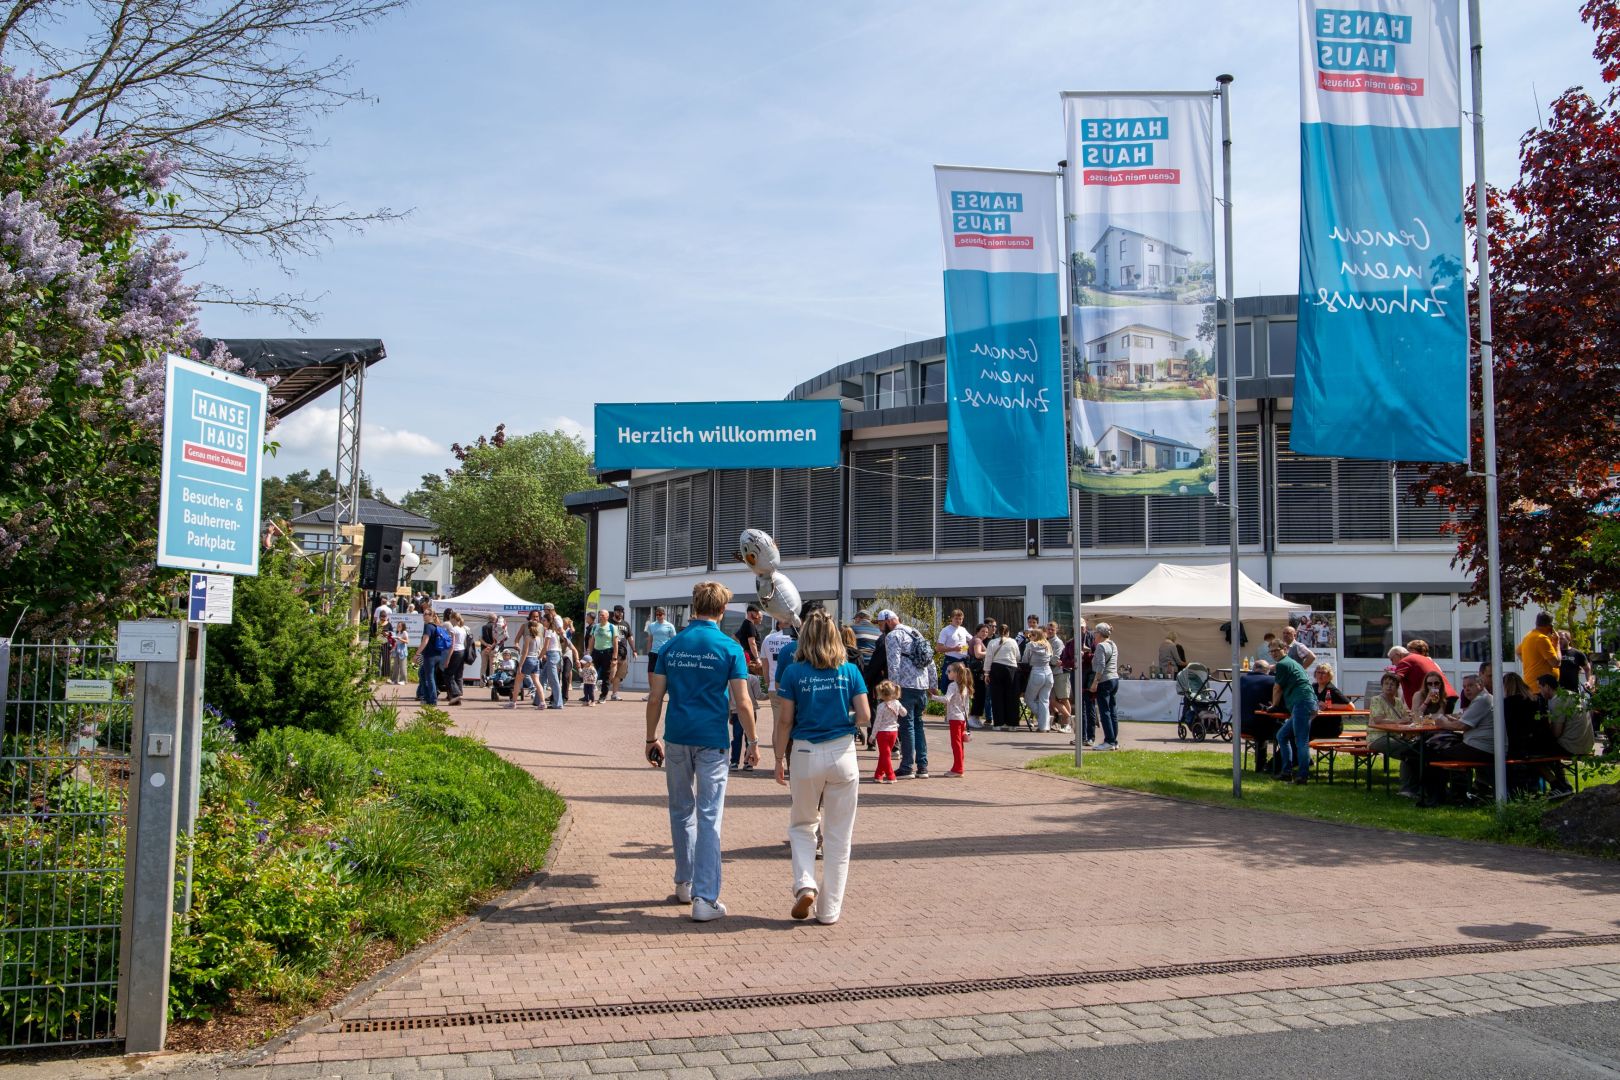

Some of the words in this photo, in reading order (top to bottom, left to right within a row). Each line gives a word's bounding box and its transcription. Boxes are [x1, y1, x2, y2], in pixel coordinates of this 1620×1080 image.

[198, 398, 245, 426] HANSE
[207, 426, 244, 450] HAUS
[618, 426, 694, 443] Herzlich
[698, 425, 817, 443] willkommen
[187, 447, 206, 460] Genau
[206, 452, 220, 463] mein
[220, 455, 244, 468] Zuhause.
[182, 487, 234, 510] Besucher-
[235, 497, 243, 512] &
[183, 508, 241, 532] Bauherren-
[187, 530, 236, 552] Parkplatz
